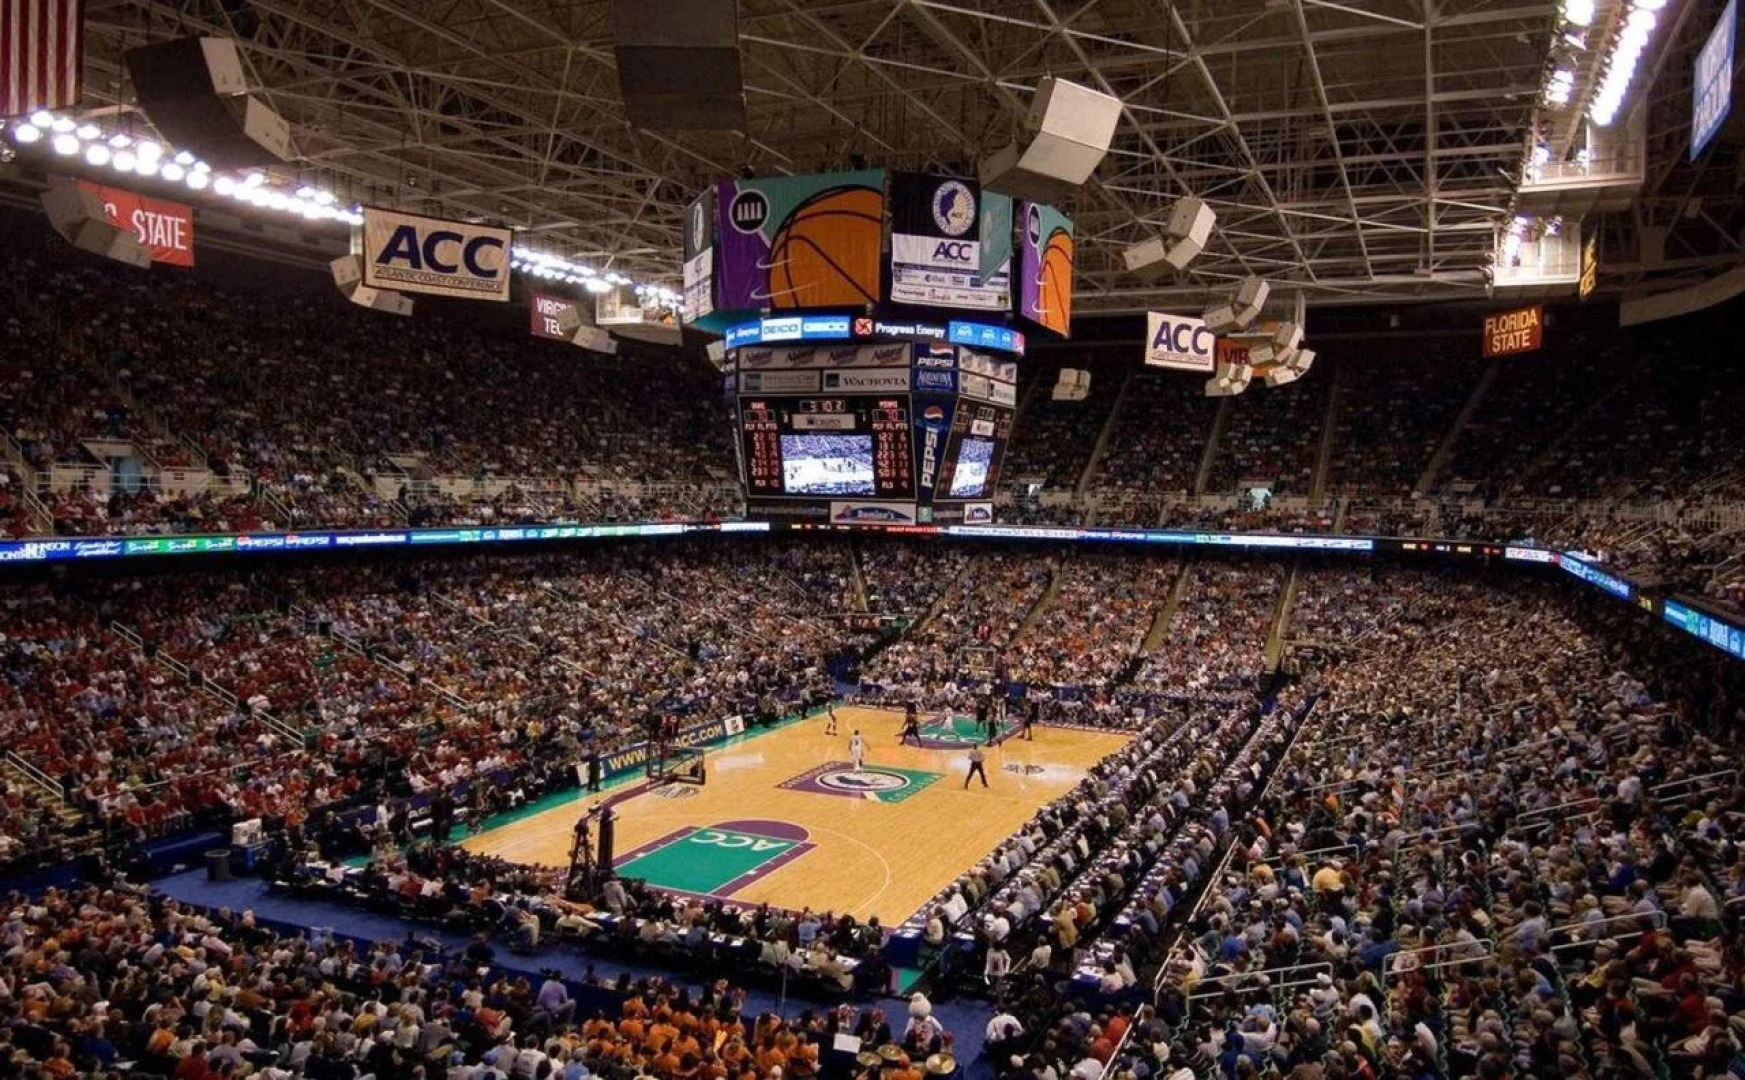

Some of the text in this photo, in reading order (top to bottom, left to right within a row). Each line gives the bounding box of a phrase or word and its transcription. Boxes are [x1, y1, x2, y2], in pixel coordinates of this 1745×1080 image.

[131, 208, 188, 250] STATE
[375, 224, 504, 278] ACC
[933, 242, 973, 261] ACC
[762, 323, 799, 335] GEICO
[874, 322, 915, 337] Progress
[916, 324, 946, 339] Energy
[1485, 307, 1539, 336] FLORIDA
[1152, 320, 1211, 355] ACC
[1492, 329, 1531, 352] STATE
[917, 357, 954, 367] PEPSI
[843, 377, 907, 386] WACHOVIA
[921, 426, 940, 489] PEPSI
[690, 831, 789, 852] ACC
